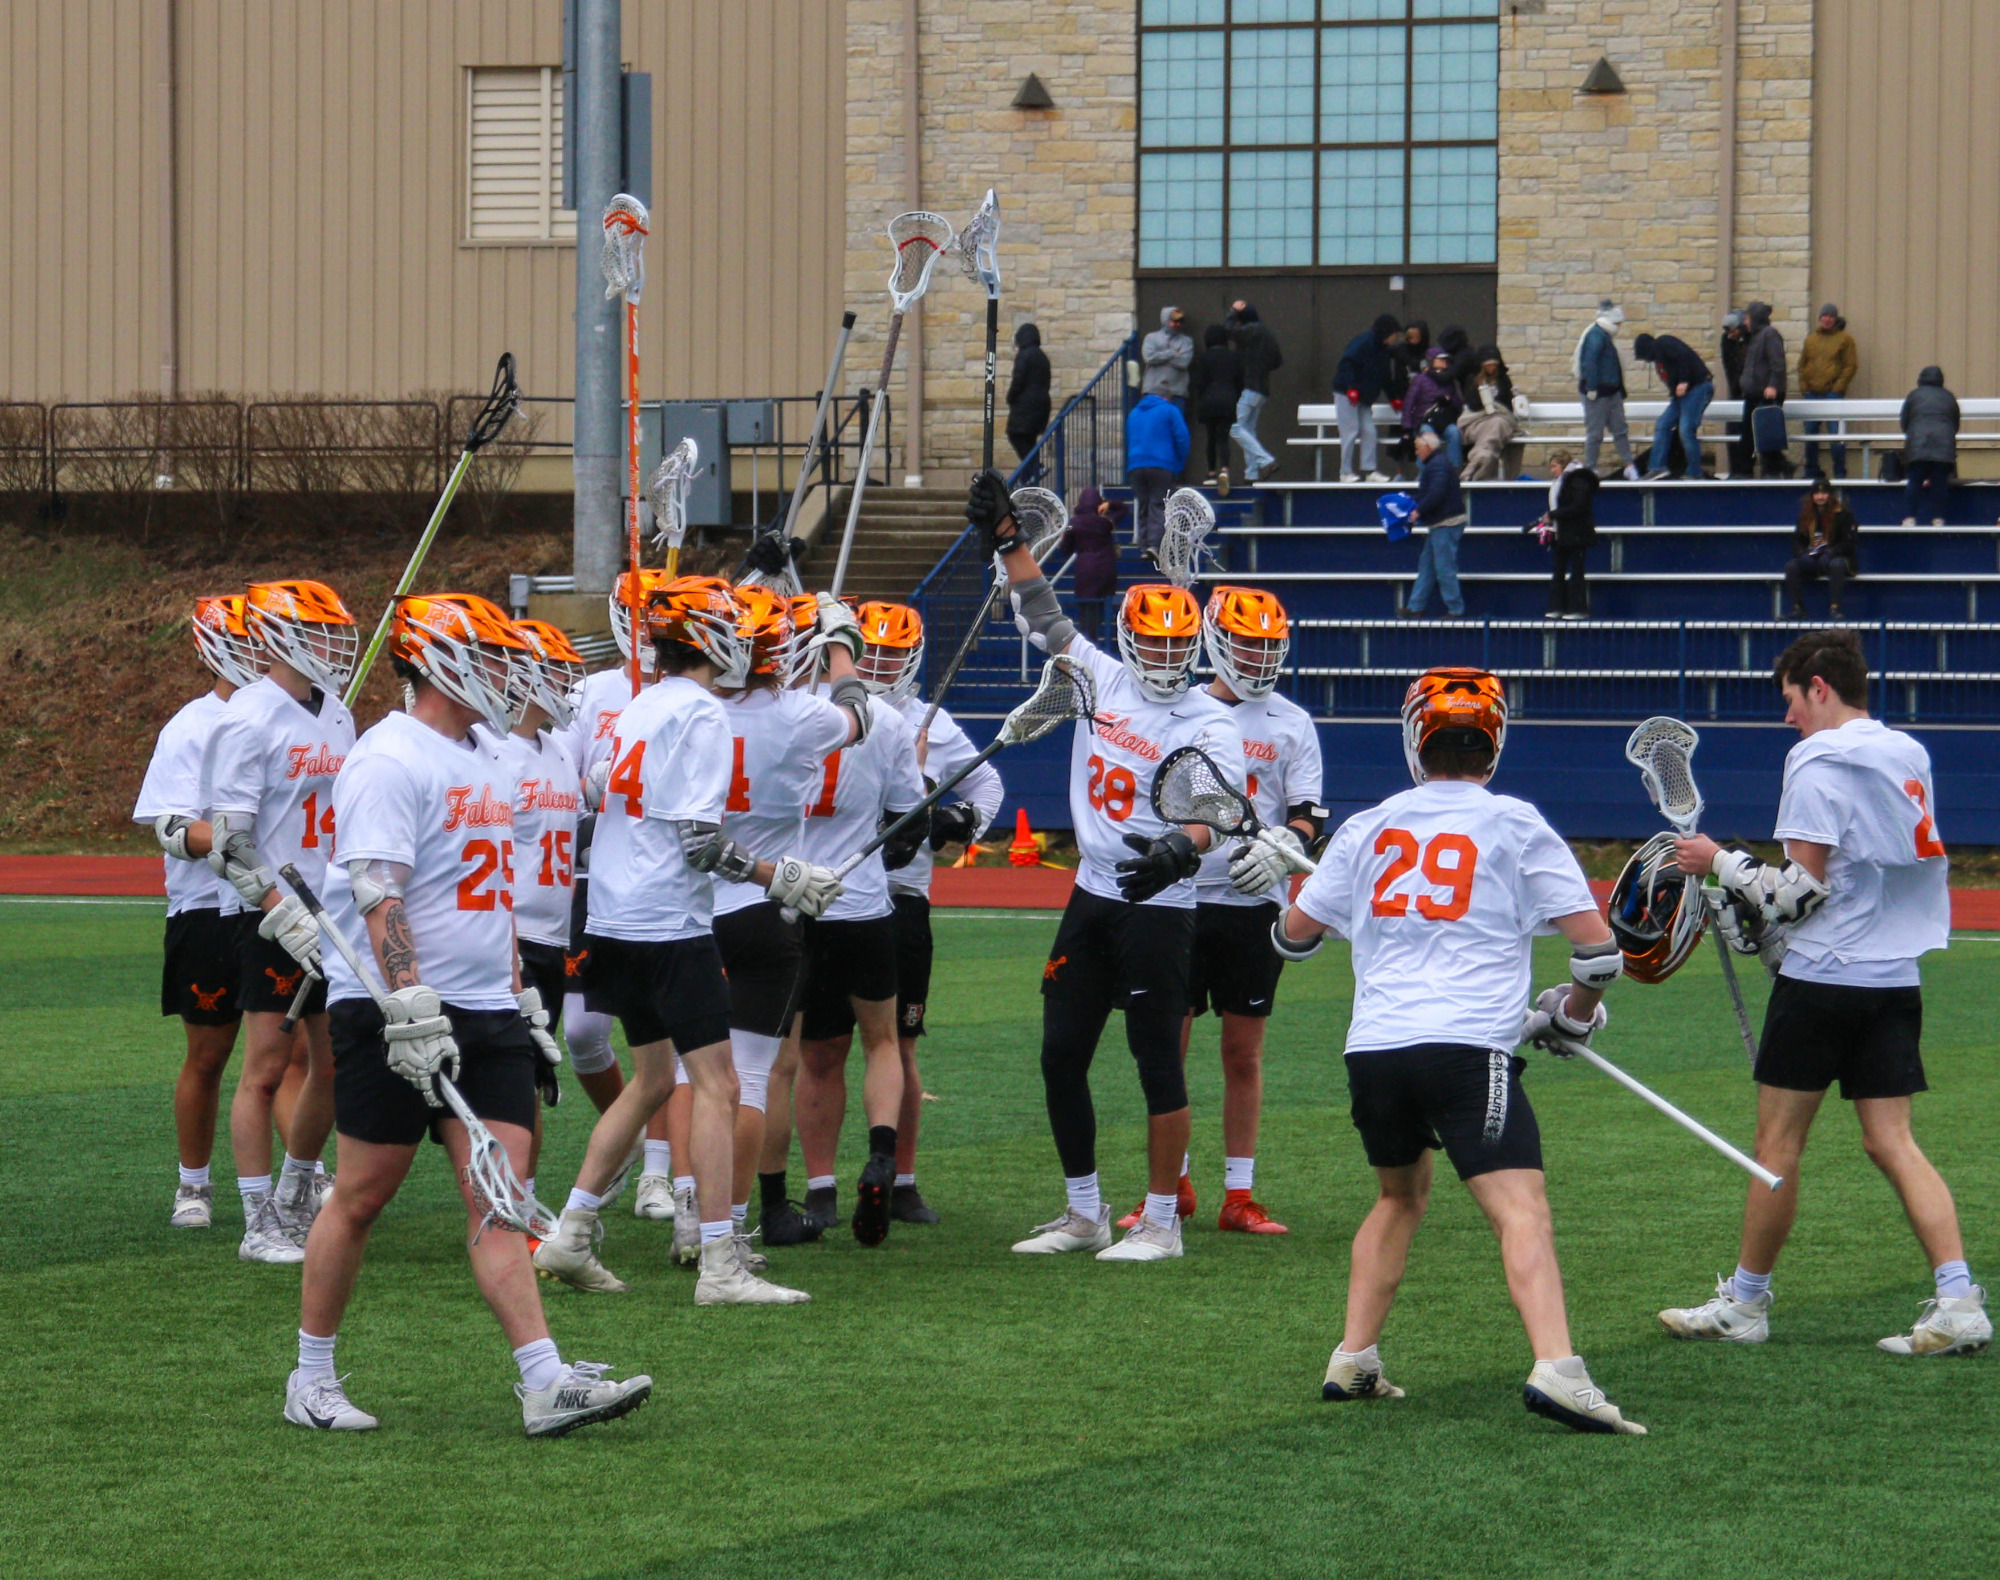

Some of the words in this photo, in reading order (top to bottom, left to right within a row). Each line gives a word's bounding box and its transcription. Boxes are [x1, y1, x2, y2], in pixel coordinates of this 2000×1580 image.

[537, 829, 572, 887] 15
[1371, 827, 1478, 921] 29
[553, 1388, 592, 1409] NIKE
